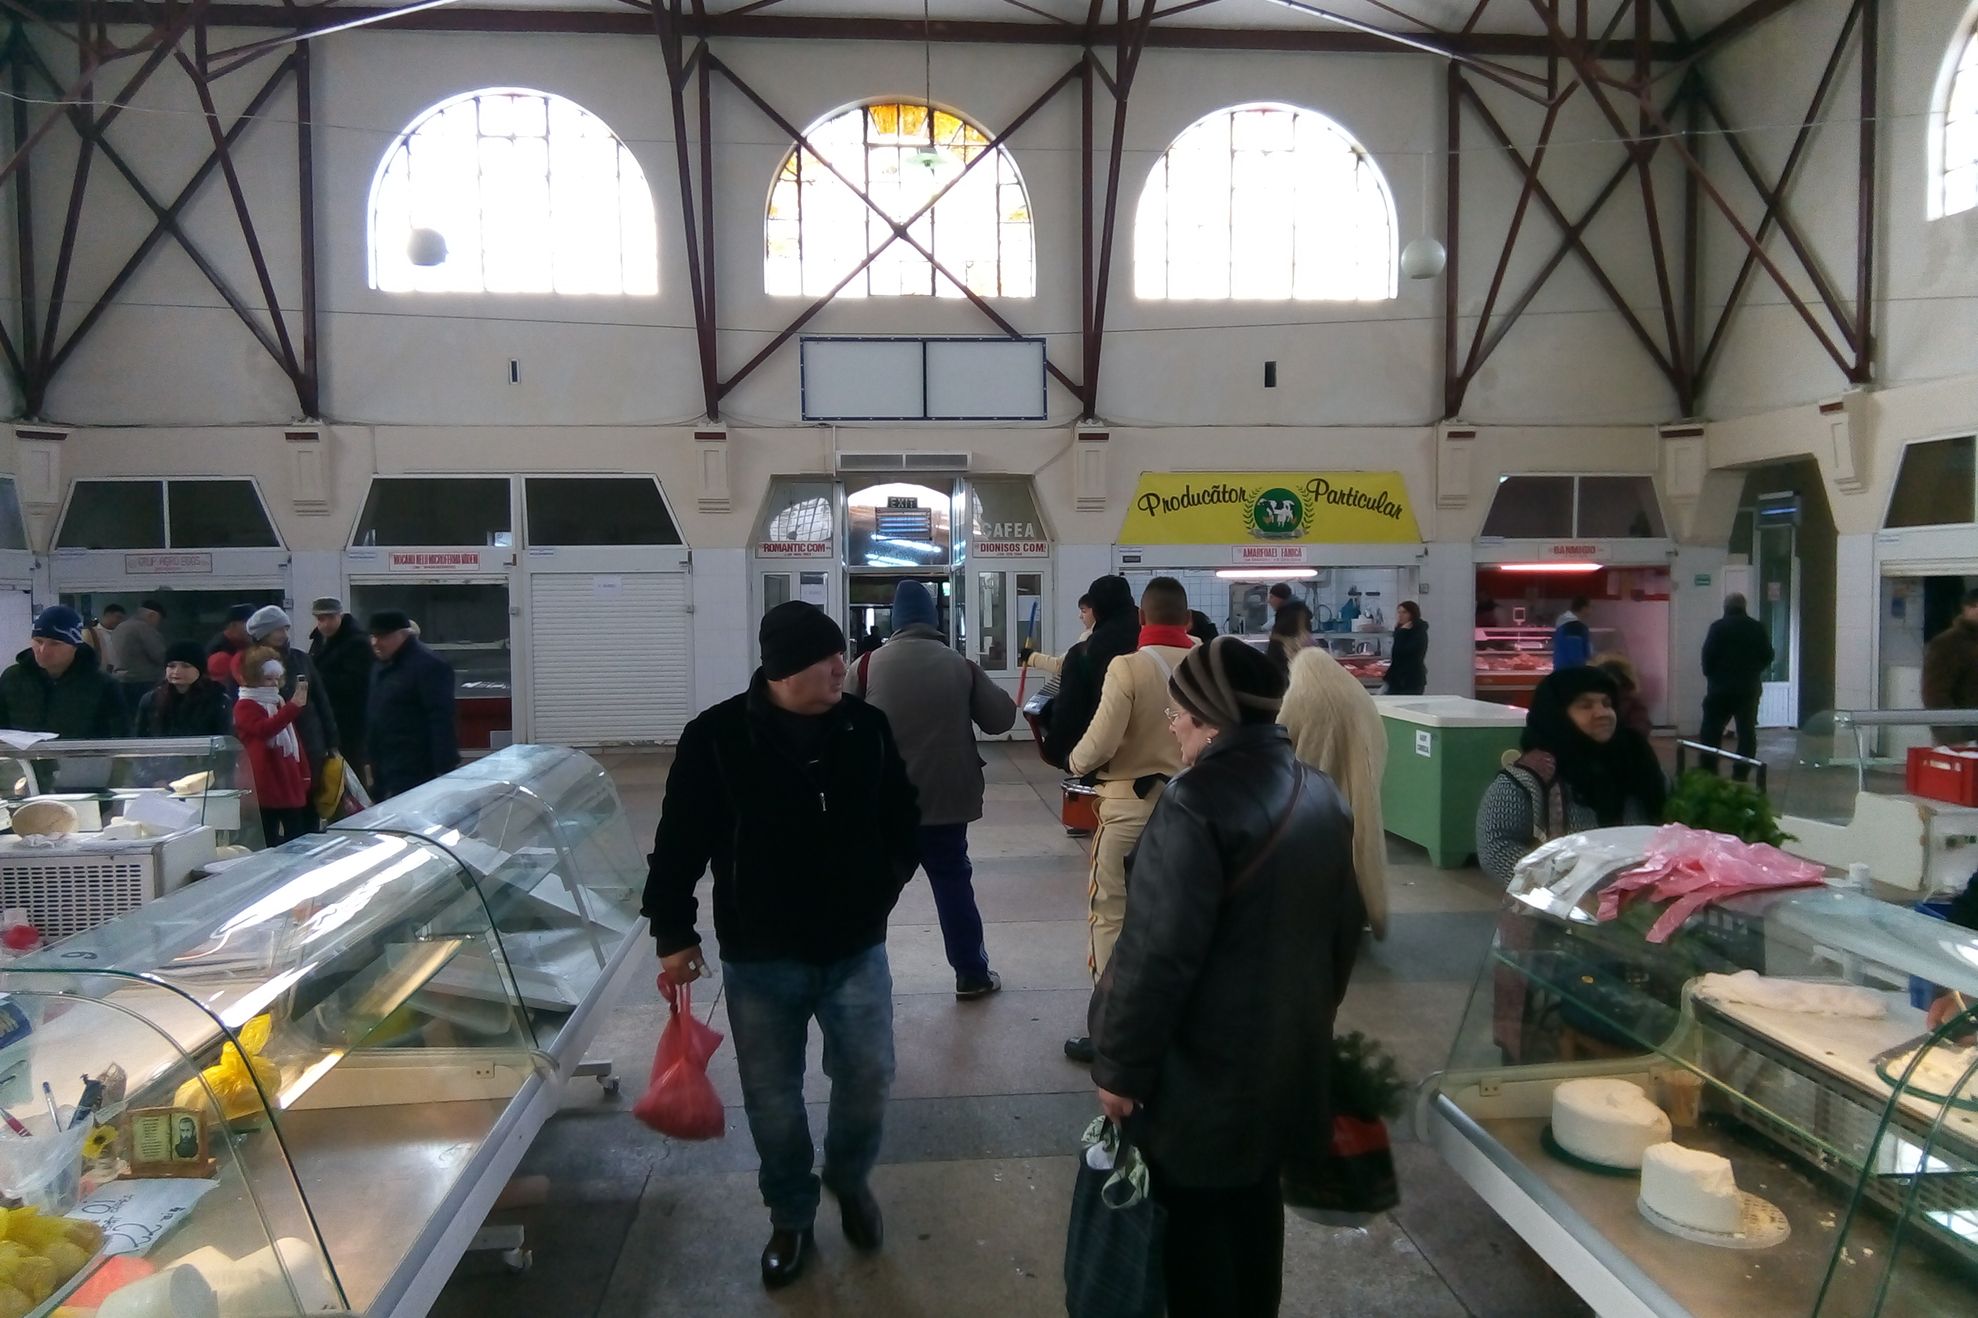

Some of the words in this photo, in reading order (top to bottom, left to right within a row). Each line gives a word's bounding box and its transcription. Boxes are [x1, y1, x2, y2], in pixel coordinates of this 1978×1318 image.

[890, 497, 915, 508] EXIT
[1306, 478, 1404, 520] Particular
[982, 522, 1035, 538] CAFEA
[763, 543, 806, 553] ROMANTIC
[807, 543, 826, 553] COM
[980, 543, 1021, 553] DIONISOS
[1023, 543, 1044, 553] COM
